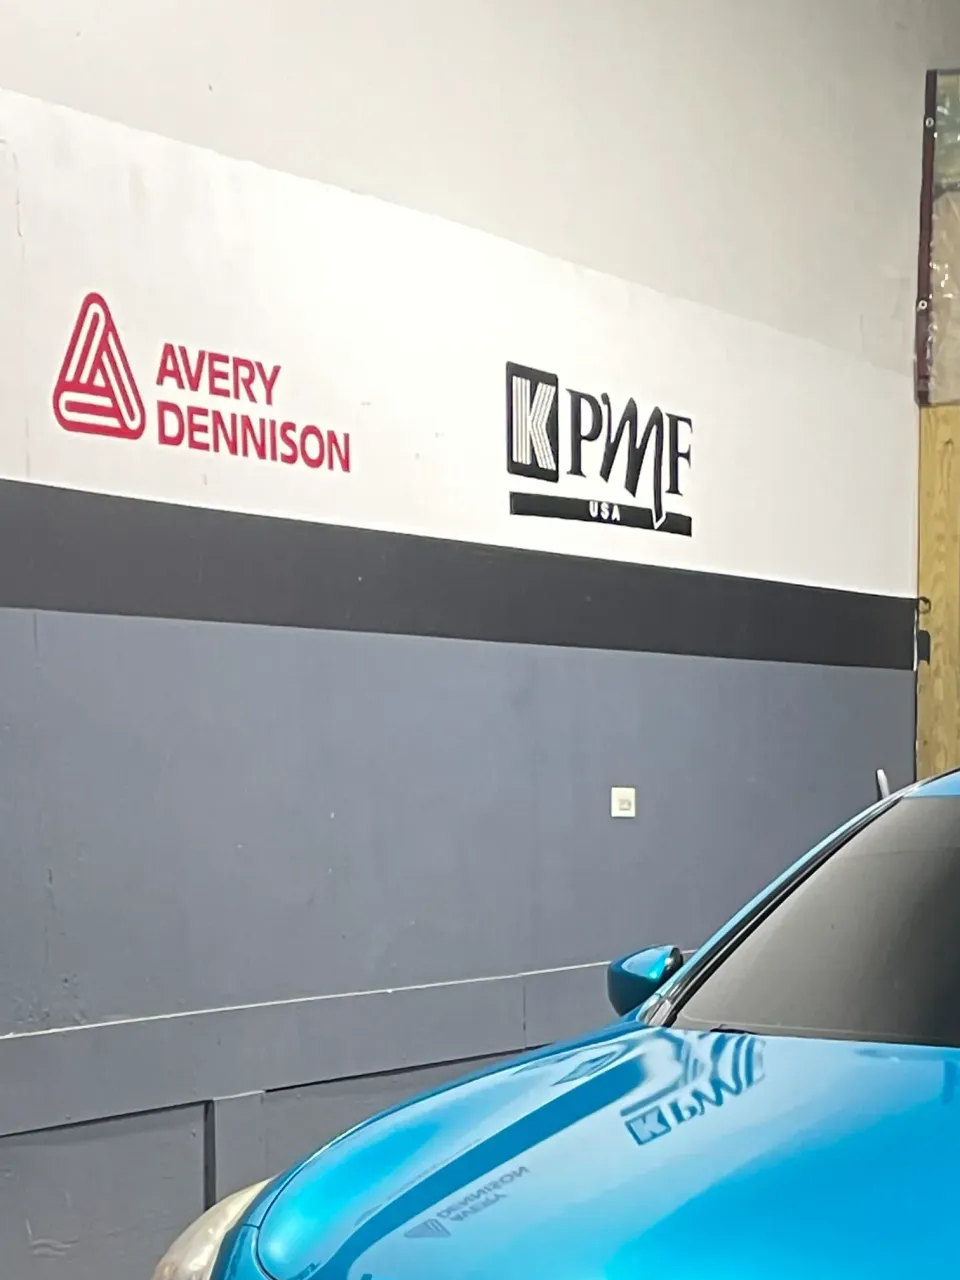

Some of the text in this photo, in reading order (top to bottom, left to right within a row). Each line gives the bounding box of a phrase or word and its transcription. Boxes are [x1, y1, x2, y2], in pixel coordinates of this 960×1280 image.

[156, 342, 281, 406] AVERY
[157, 400, 350, 473] DENNISON
[506, 361, 693, 523] KPMF
[589, 501, 620, 522] USA
